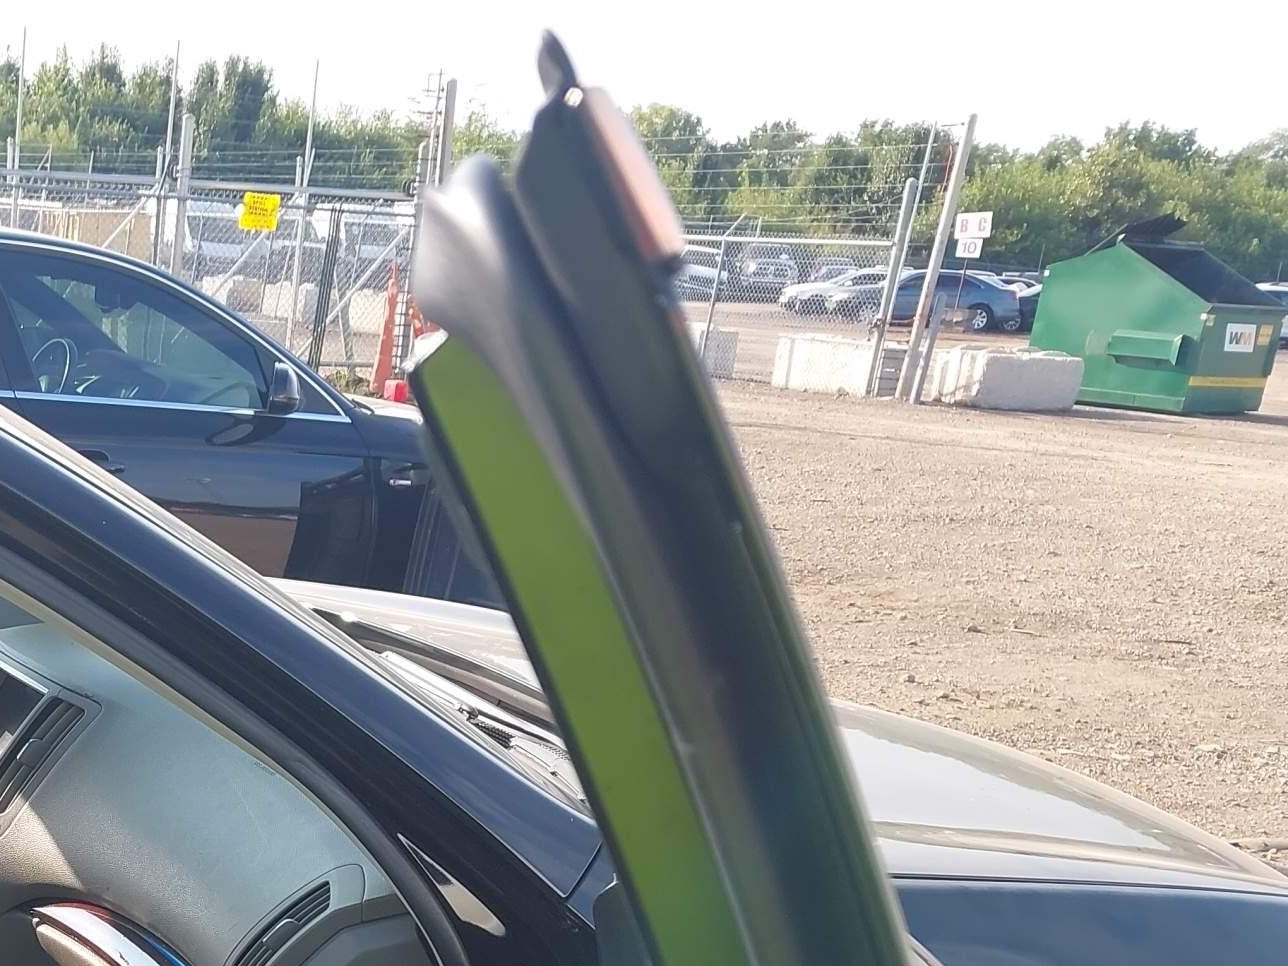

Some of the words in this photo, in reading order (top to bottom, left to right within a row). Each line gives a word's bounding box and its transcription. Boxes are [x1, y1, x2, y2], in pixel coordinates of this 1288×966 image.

[960, 219, 968, 233] B
[978, 217, 987, 232] C
[961, 241, 977, 254] 10
